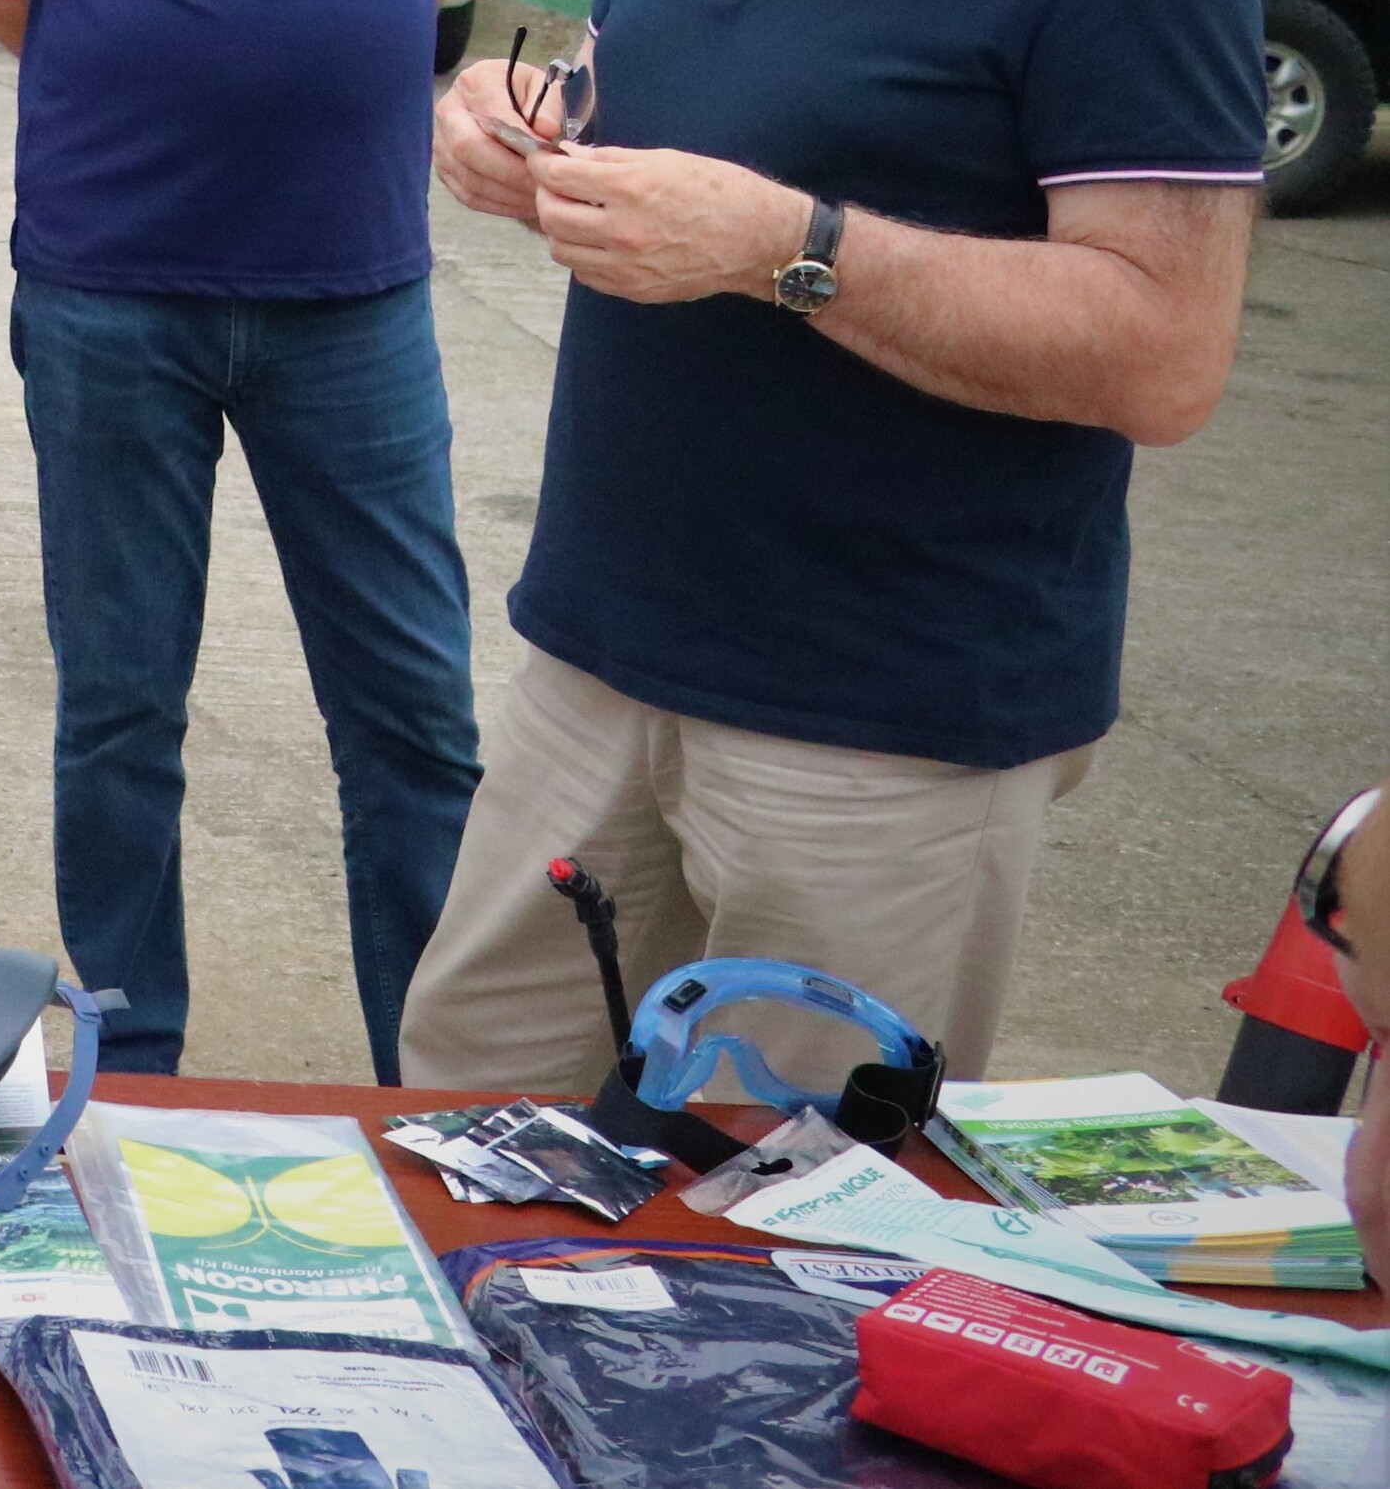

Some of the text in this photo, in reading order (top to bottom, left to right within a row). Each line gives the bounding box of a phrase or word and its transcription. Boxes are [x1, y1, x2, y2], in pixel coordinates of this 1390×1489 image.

[193, 1255, 382, 1279] Insect Monitoring Kit
[175, 1263, 408, 1297] PHEROCON
[176, 1402, 211, 1416] 4XL
[226, 1404, 261, 1416] 3XL
[272, 1404, 323, 1418] 2XL
[333, 1406, 357, 1417] XL
[388, 1406, 410, 1418] M
